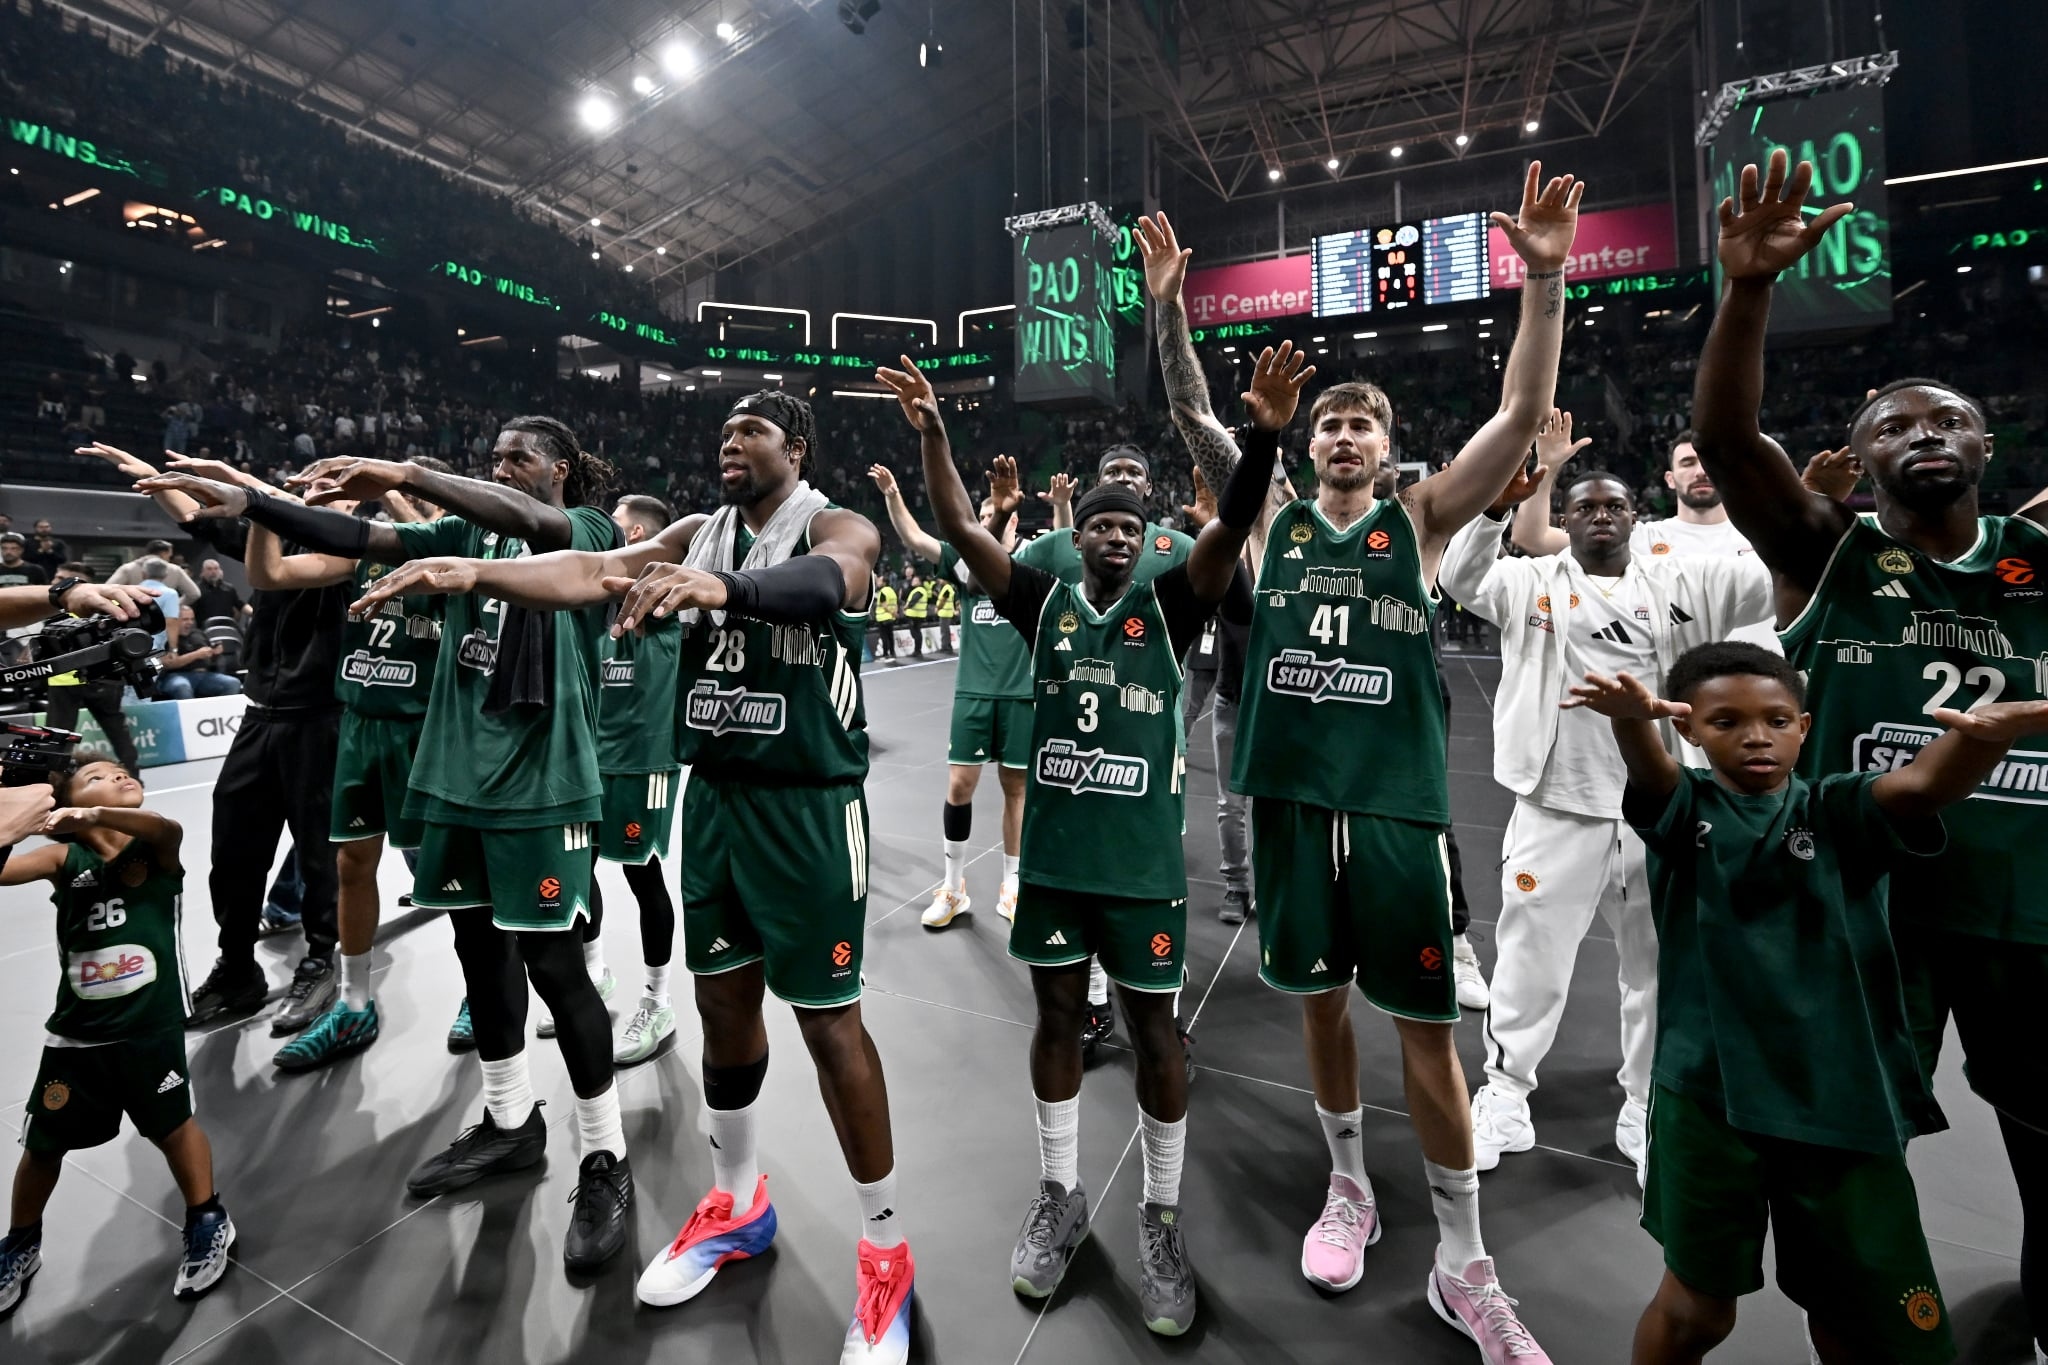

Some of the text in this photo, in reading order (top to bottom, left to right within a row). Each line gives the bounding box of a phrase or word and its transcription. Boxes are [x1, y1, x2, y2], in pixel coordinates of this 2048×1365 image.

[9, 117, 97, 165] WINS
[220, 187, 350, 244] PAO WINS
[1973, 229, 2028, 250] PAO
[1564, 245, 1649, 274] enter
[446, 261, 534, 302] PAO WINS
[1028, 257, 1079, 306] PAO
[1608, 276, 1657, 294] WINS
[1221, 289, 1308, 315] Center
[600, 311, 664, 343] PAO WINS
[1020, 313, 1088, 364] WINS
[1217, 324, 1253, 338] WINS
[737, 348, 768, 361] WINS
[795, 353, 861, 367] PAO WINS
[916, 354, 976, 369] PAO WINS
[368, 618, 396, 648] 72
[1309, 604, 1350, 645] 41
[706, 629, 745, 672] 28
[1284, 654, 1308, 664] pame
[4, 664, 53, 683] RONIN
[1922, 661, 2006, 715] 22
[1077, 692, 1098, 733] 3
[1050, 744, 1070, 754] pame
[1881, 730, 1933, 746] pame
[87, 897, 127, 932] 26
[81, 954, 144, 983] Dole
[157, 1077, 184, 1093] adidas
